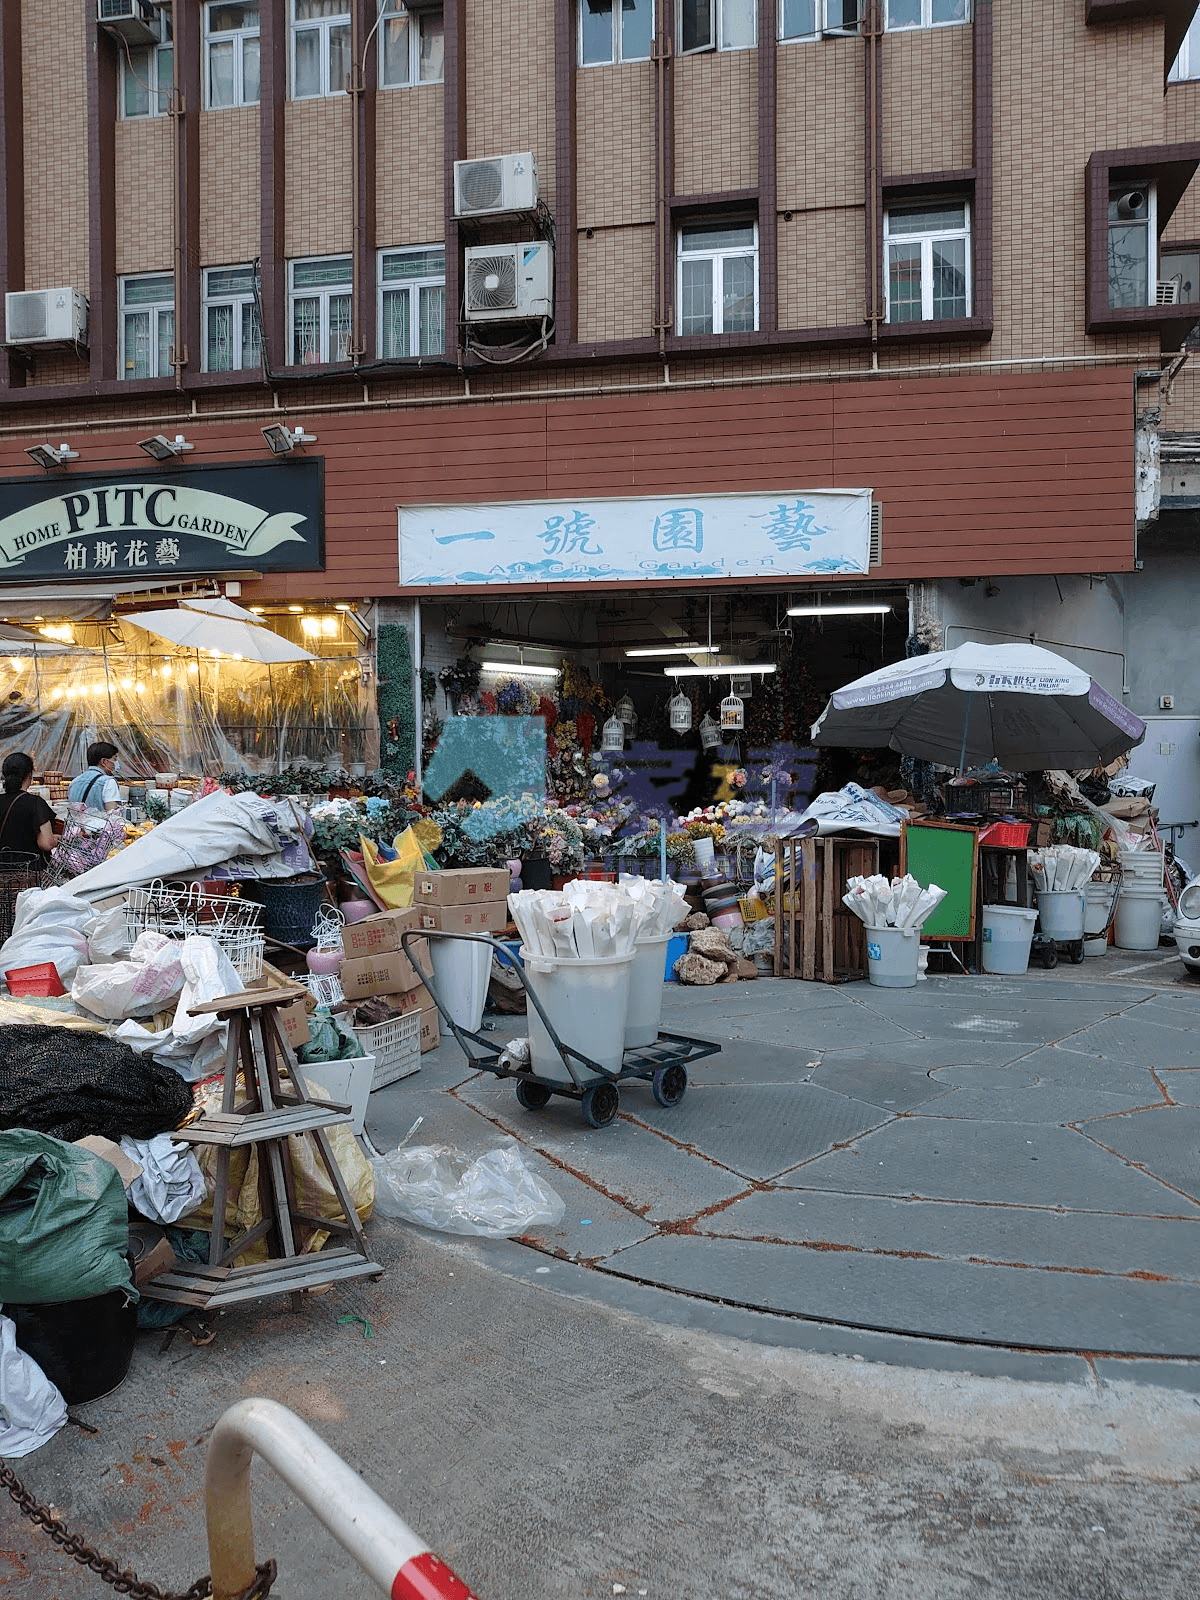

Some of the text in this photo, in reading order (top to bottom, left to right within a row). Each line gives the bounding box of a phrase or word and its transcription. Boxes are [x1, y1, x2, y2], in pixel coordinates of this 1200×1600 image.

[13, 487, 249, 551] HOME PITC GARDEN
[430, 499, 830, 556] 一號園藝
[64, 538, 181, 571] 柏斯花藝
[638, 555, 777, 573] Garden
